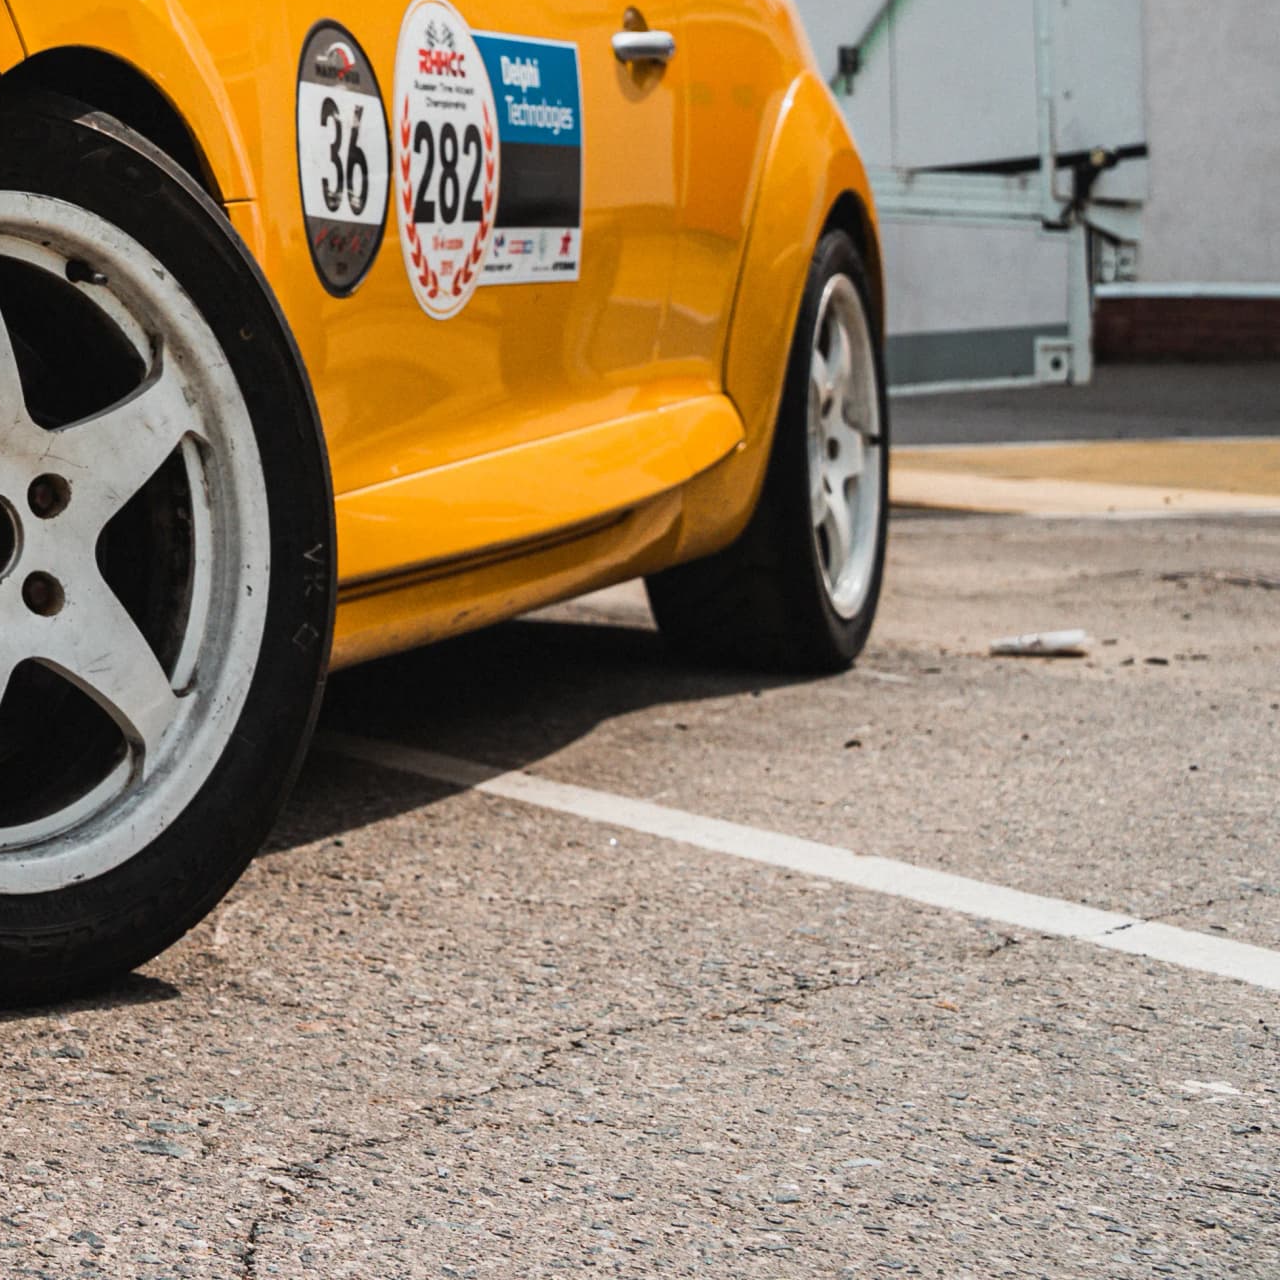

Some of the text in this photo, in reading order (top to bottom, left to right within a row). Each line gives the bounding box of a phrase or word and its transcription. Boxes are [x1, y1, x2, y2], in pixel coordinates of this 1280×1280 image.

[500, 55, 540, 93] Delphi
[504, 95, 573, 135] Technologies
[320, 97, 369, 216] 36
[412, 120, 483, 224] 282
